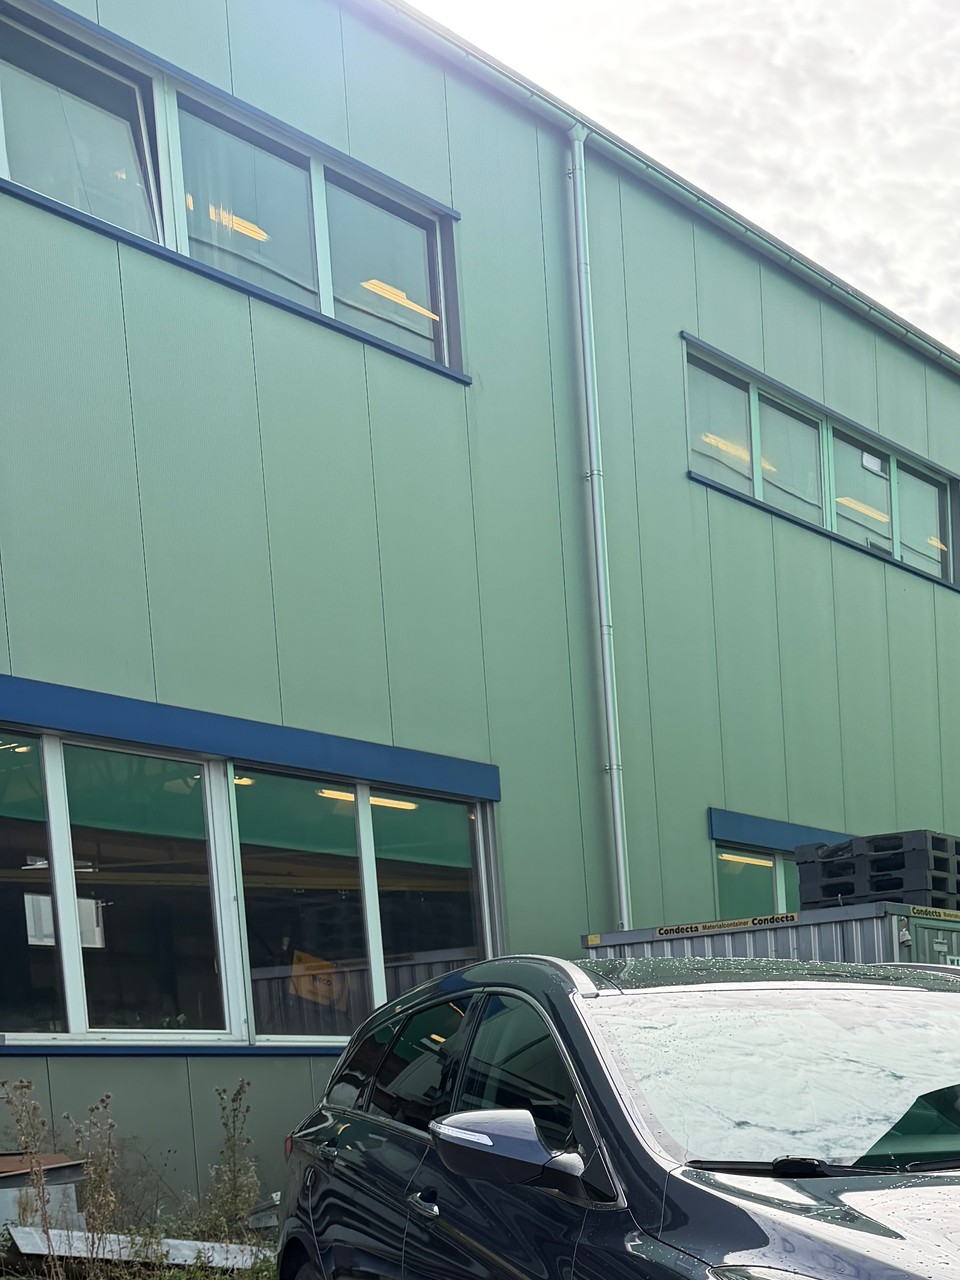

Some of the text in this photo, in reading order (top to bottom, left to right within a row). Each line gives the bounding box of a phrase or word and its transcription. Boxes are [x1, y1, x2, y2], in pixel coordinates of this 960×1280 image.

[912, 907, 942, 918] Condecta
[658, 914, 795, 936] Condecta Materialcontainer Condecta
